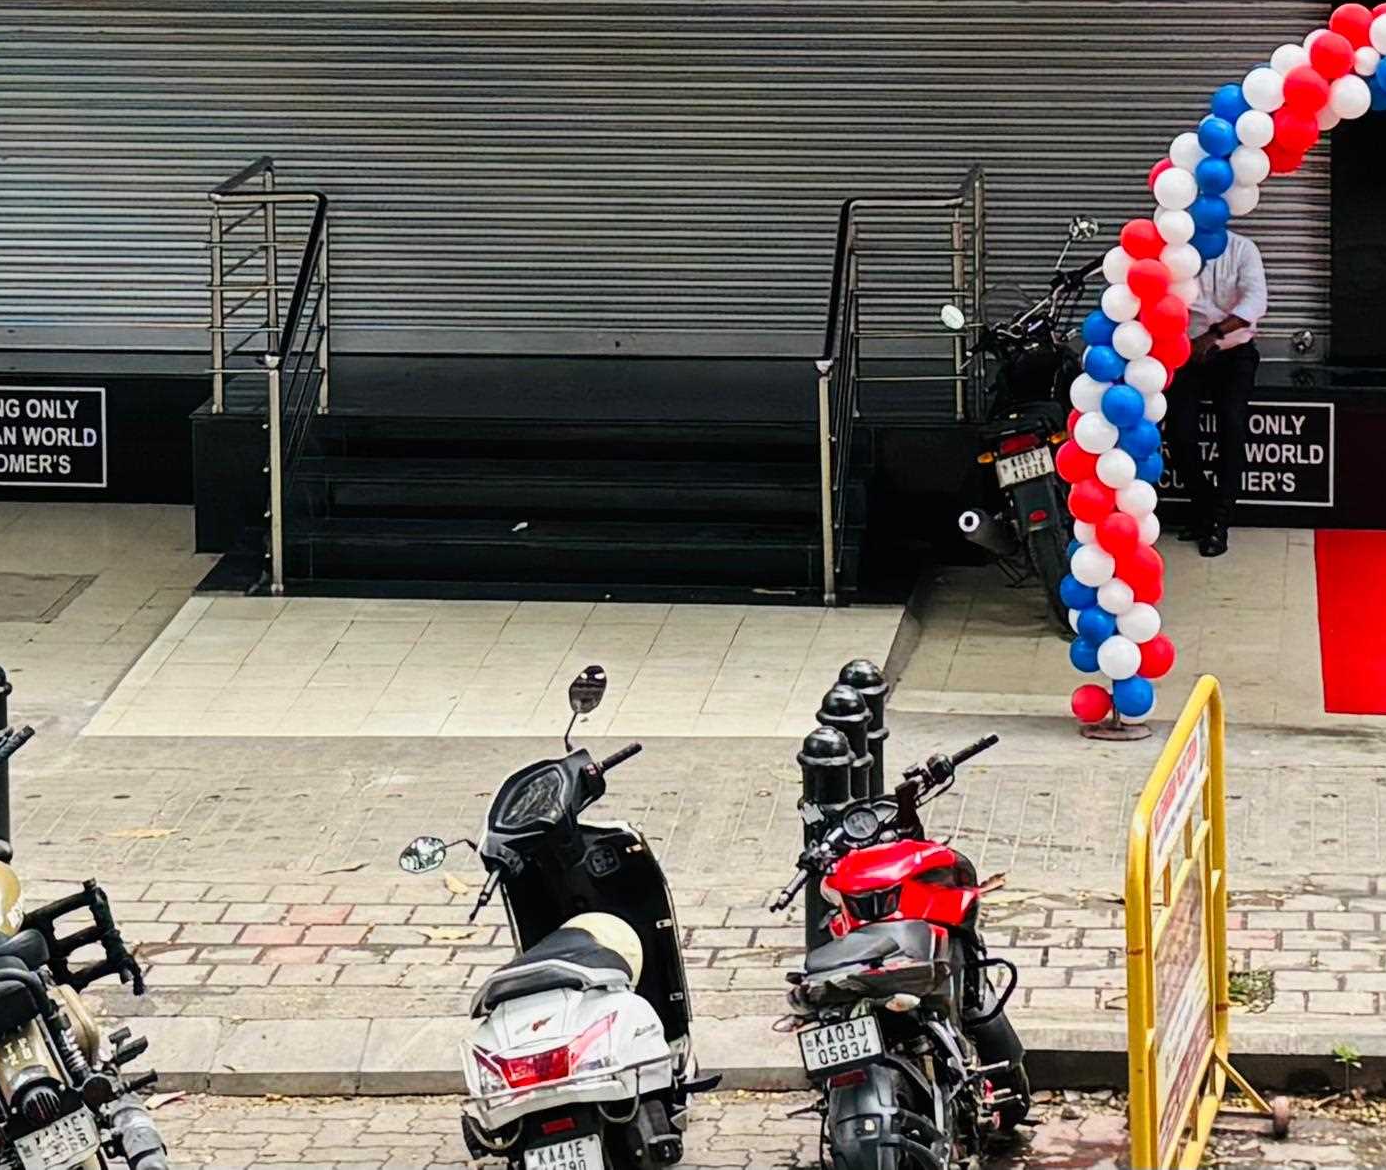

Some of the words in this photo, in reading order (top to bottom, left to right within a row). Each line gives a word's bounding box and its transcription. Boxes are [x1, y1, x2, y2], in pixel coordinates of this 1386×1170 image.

[25, 399, 79, 419] ONLY
[1248, 414, 1306, 435] ONLY
[22, 427, 97, 447] WORLD
[1245, 443, 1324, 465] WORLD
[814, 1020, 867, 1047] KA03J
